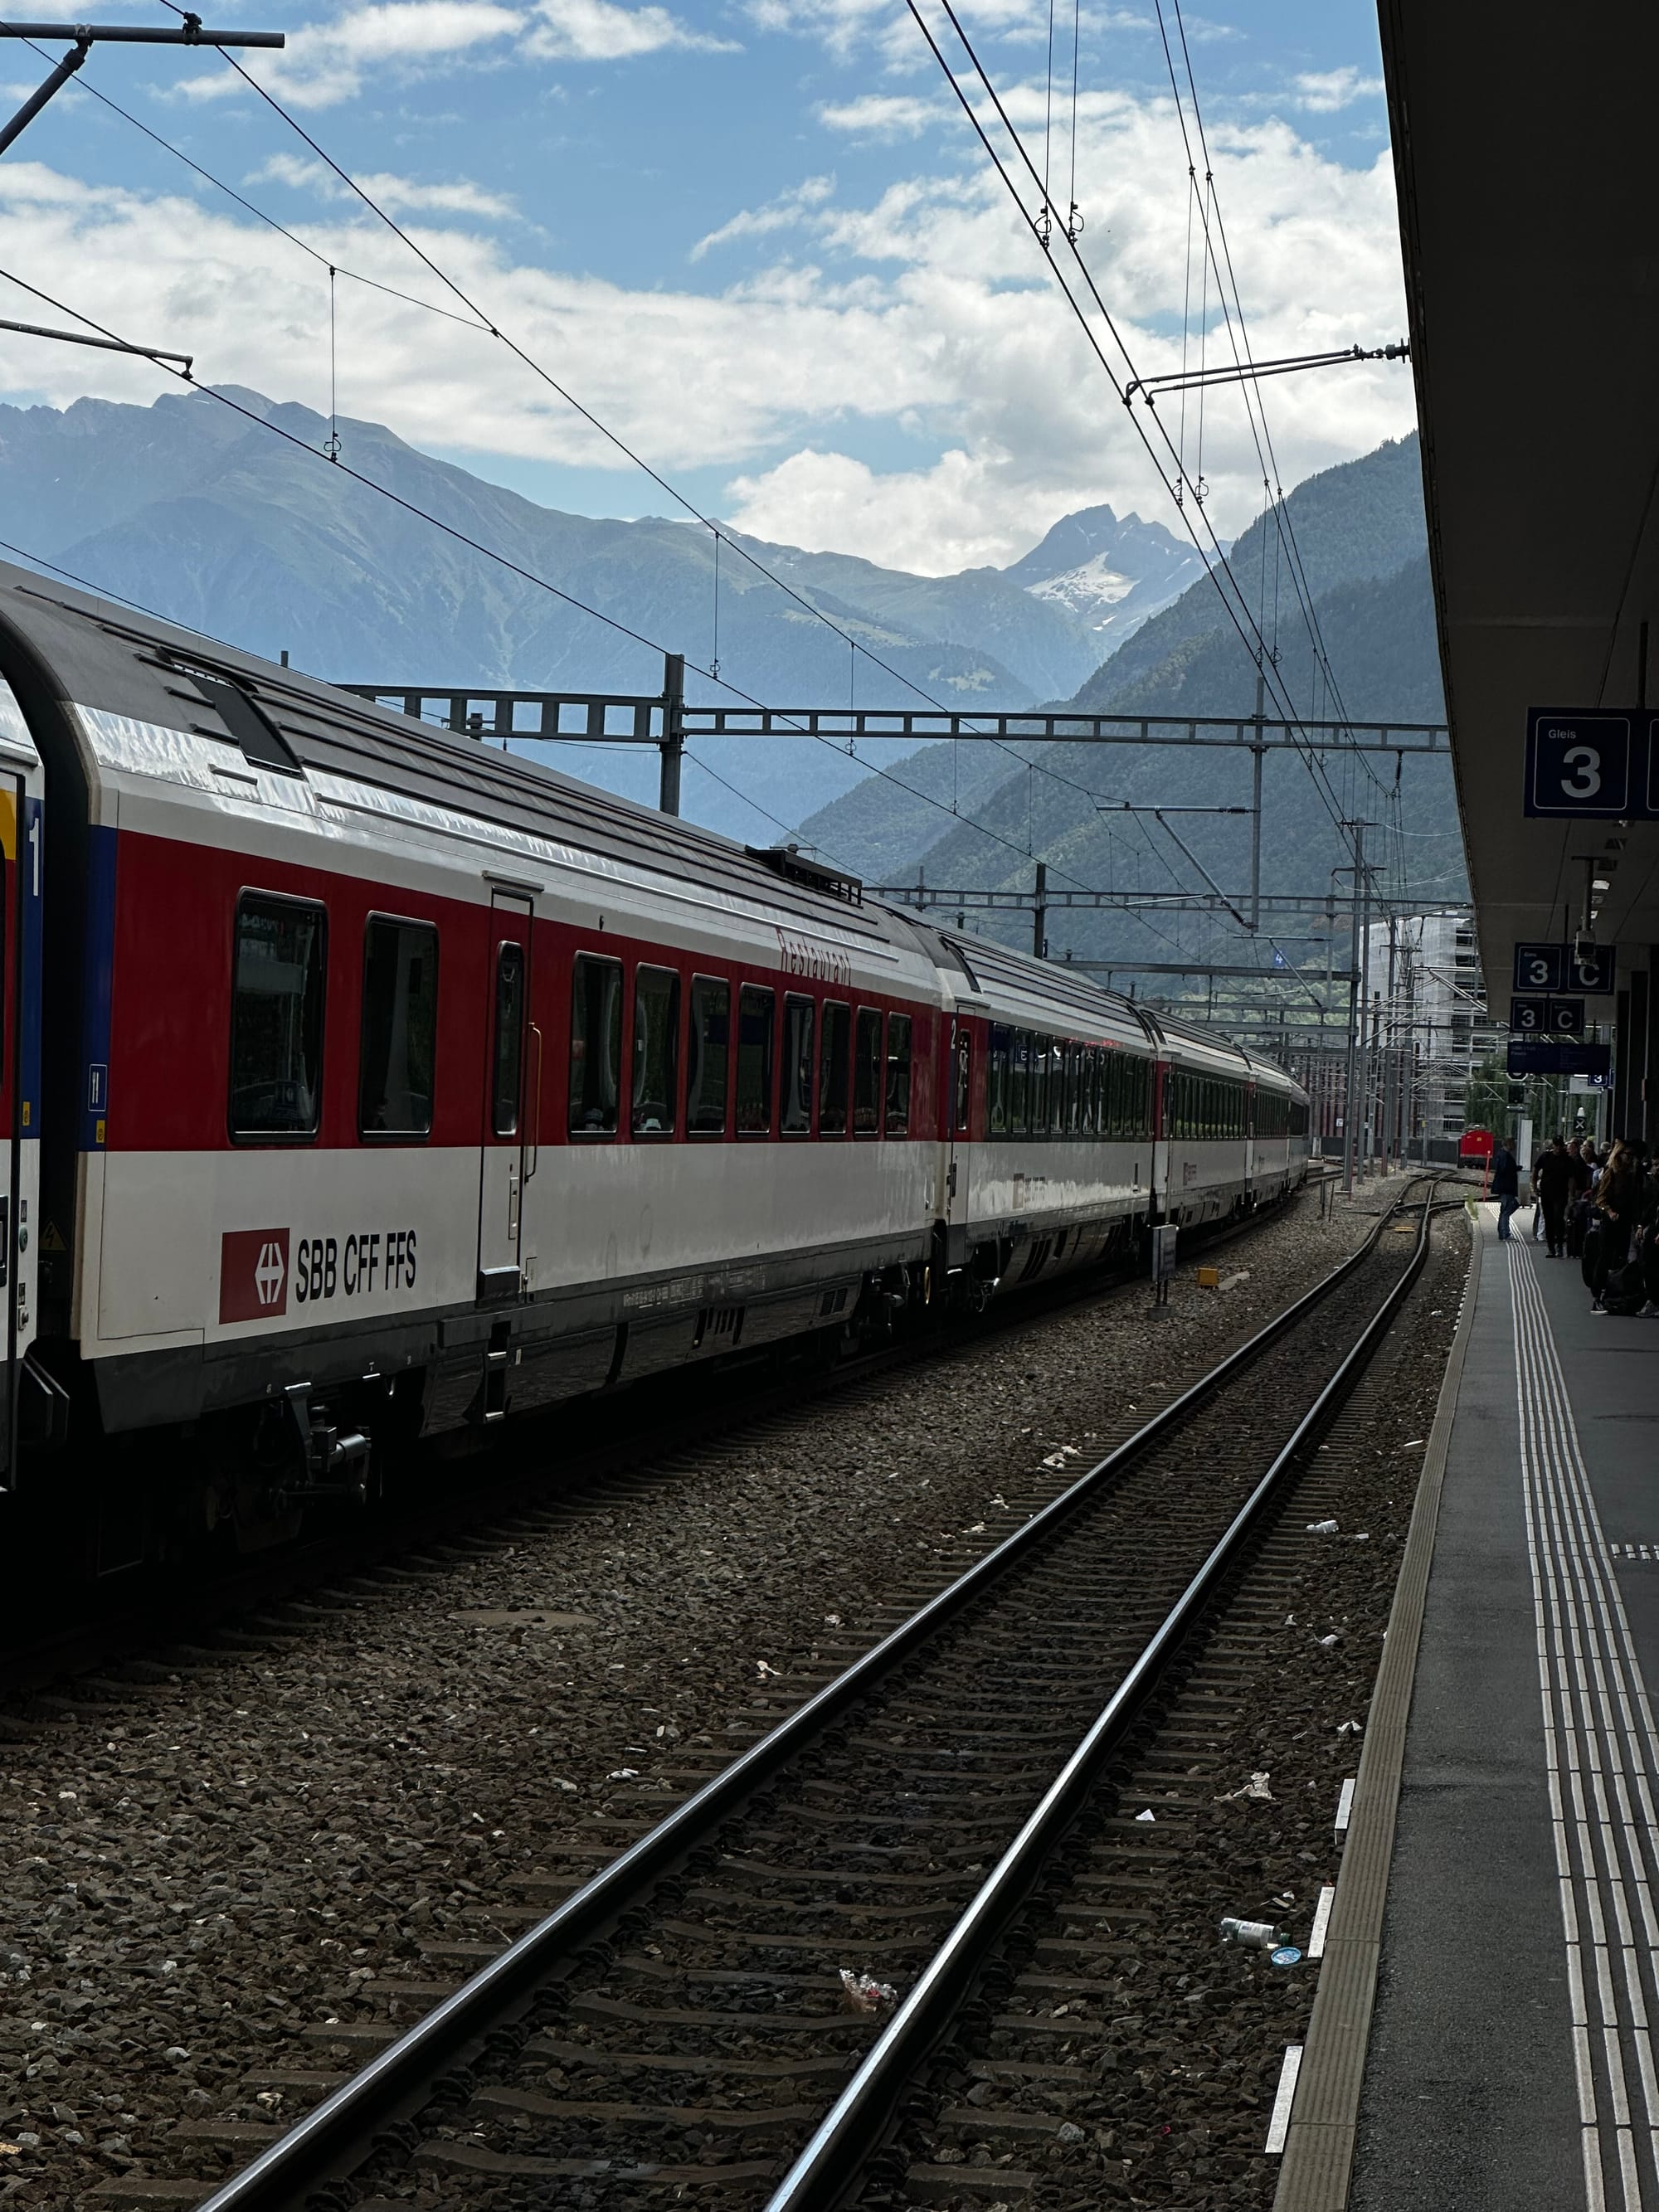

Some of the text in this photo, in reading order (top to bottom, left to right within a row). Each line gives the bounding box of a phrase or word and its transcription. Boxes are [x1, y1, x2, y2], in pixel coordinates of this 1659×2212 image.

[1548, 729, 1577, 739] Gleis
[1560, 746, 1602, 799] 3
[28, 817, 39, 897] 1
[775, 926, 851, 987] Restaurant
[1276, 953, 1283, 964] 4
[1529, 960, 1600, 987] 3 C
[1520, 1009, 1574, 1029] 3 C
[951, 1018, 956, 1050] 2
[1593, 1075, 1603, 1083] 3
[295, 1229, 417, 1303] SBB CFF FFS
